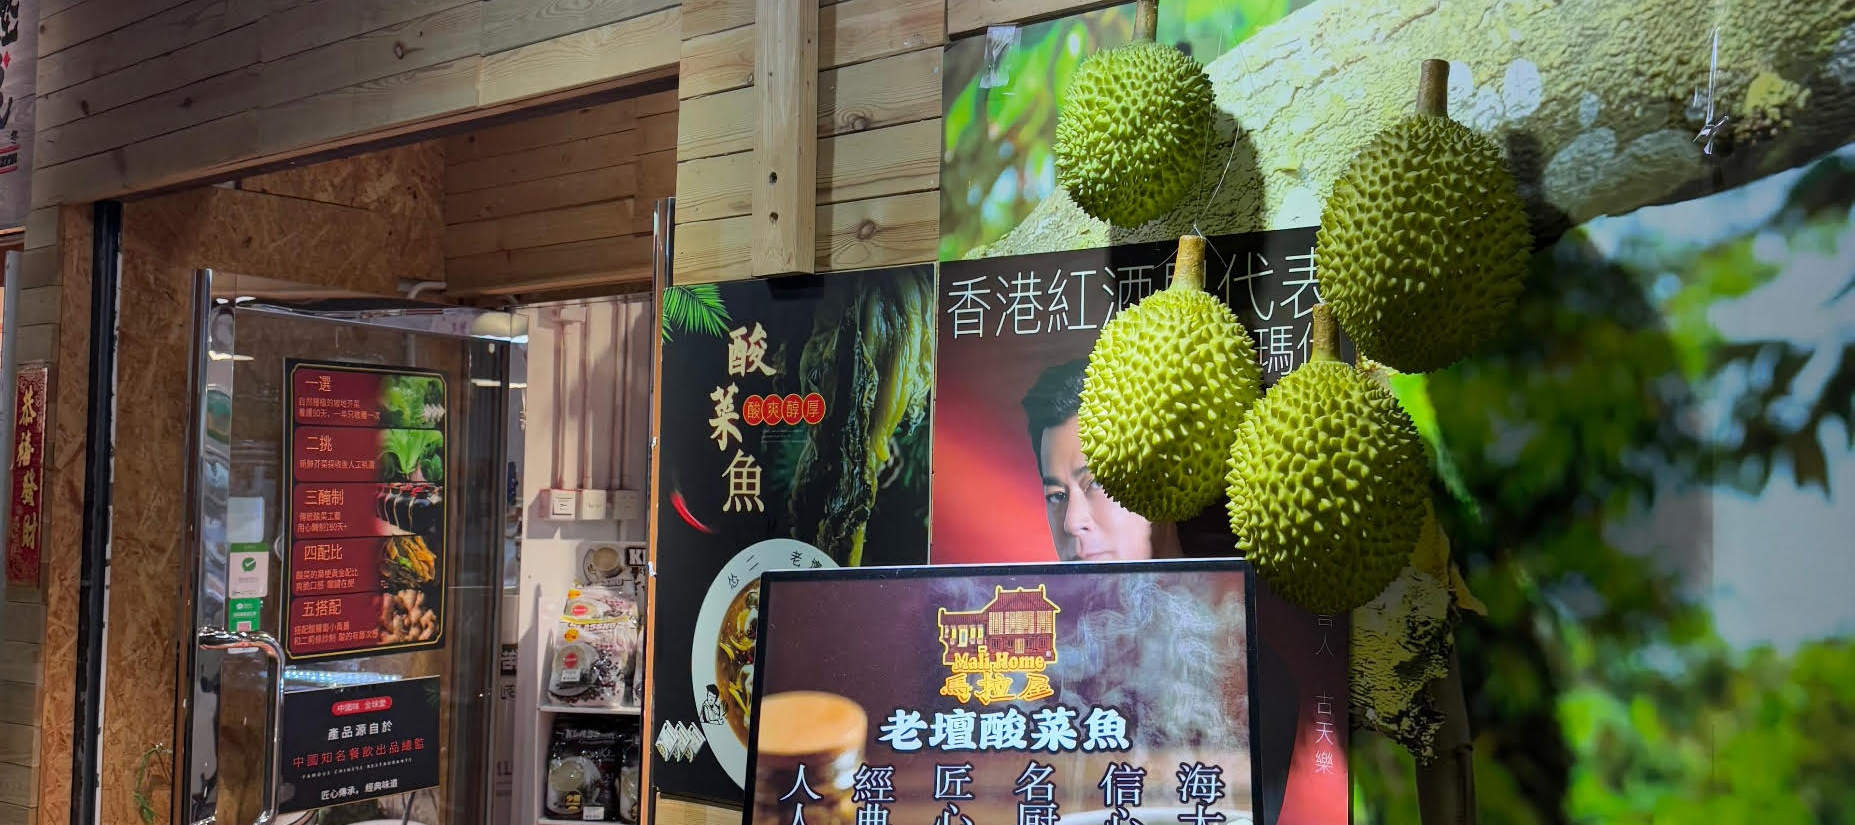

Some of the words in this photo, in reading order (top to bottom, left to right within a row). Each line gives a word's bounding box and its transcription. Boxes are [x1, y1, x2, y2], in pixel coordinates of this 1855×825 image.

[947, 246, 1324, 340] 香港紅酒代表
[304, 376, 331, 392] 一選
[708, 321, 777, 513] 酸菜魚
[747, 399, 820, 420] 酸爽醇厚
[306, 436, 333, 452] 二挑
[304, 544, 343, 561] 四配比
[302, 598, 342, 617] 五搭配
[952, 652, 990, 671] Mali
[993, 651, 1046, 671] Home
[328, 720, 393, 741] 產品源自於
[878, 706, 1130, 751] 老壇酸菜魚
[1314, 689, 1335, 774] 古天樂
